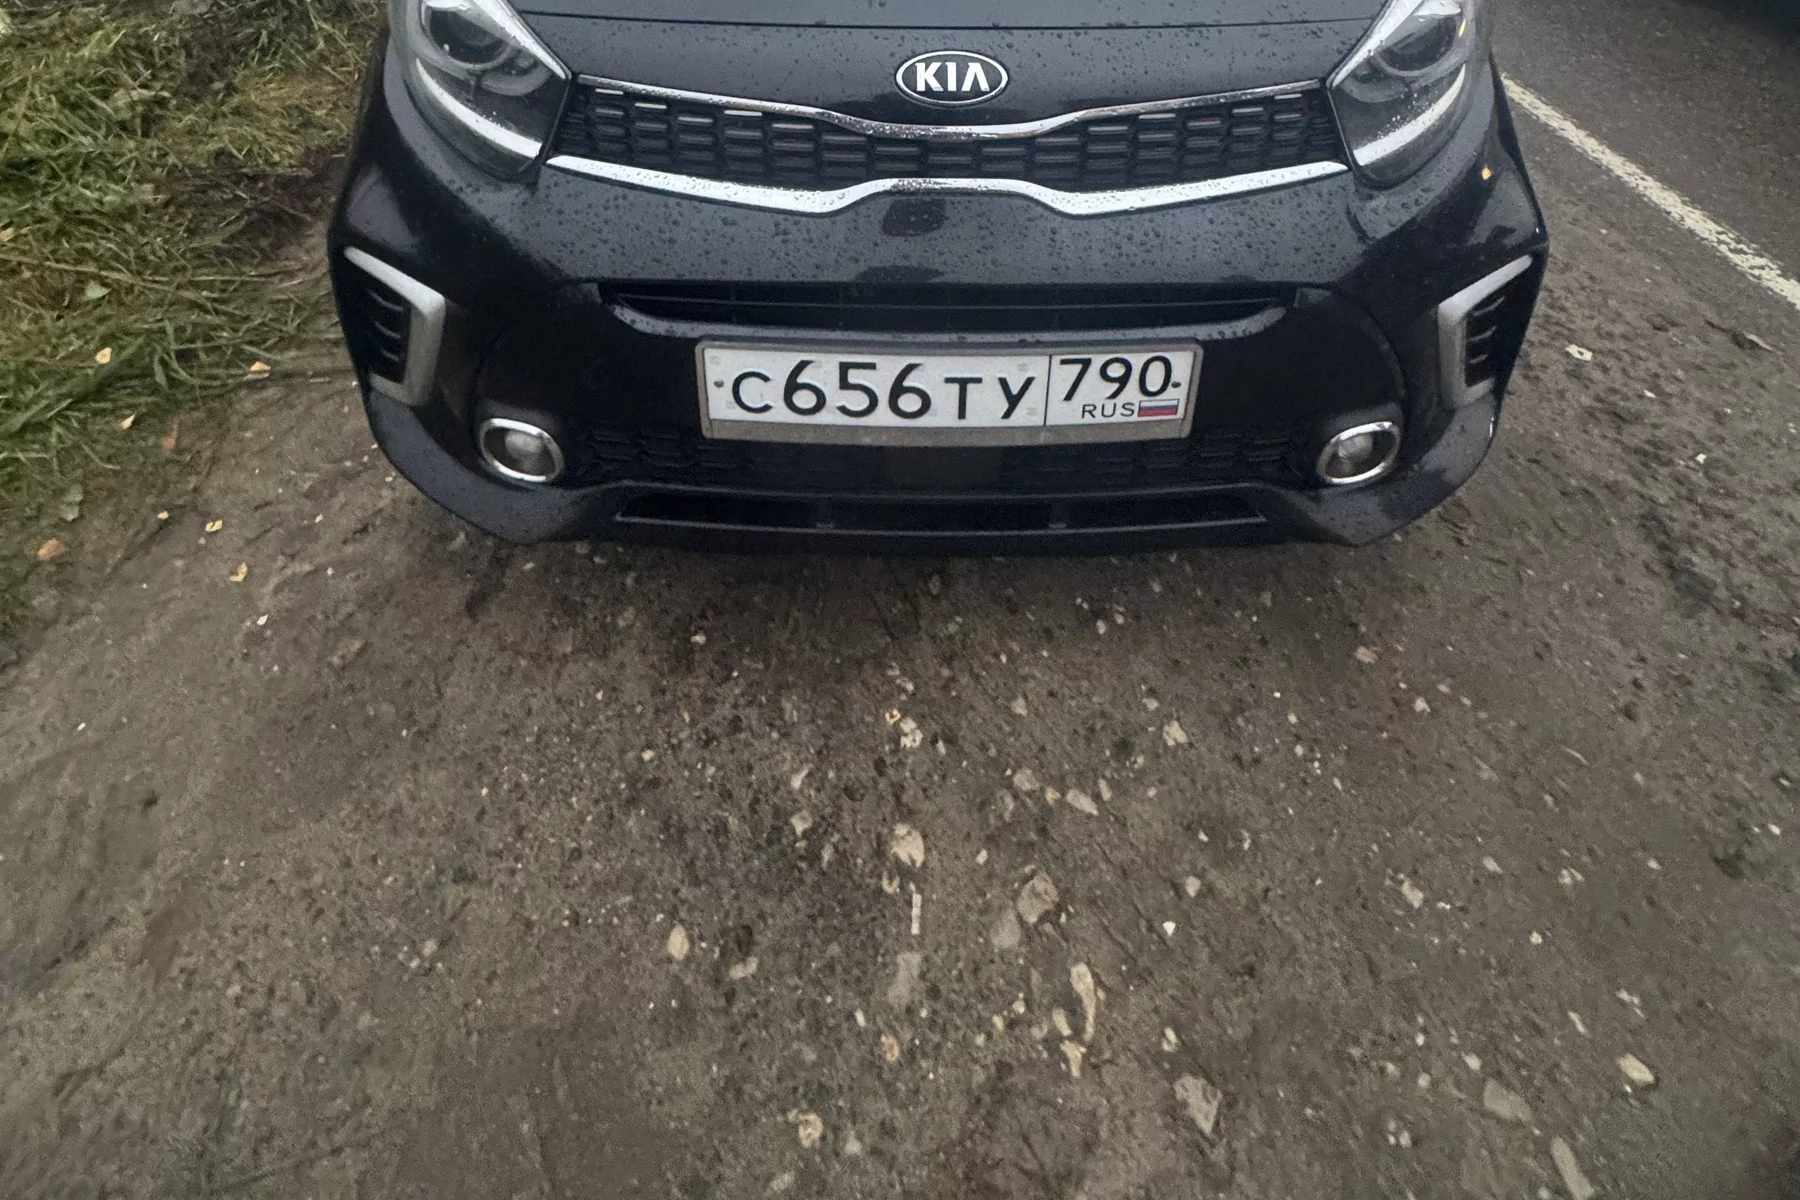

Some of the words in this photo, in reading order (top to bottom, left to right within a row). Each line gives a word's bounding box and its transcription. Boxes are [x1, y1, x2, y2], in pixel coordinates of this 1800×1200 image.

[915, 62, 990, 92] KIA
[1059, 355, 1172, 401] 790
[1081, 402, 1135, 419] RUS
